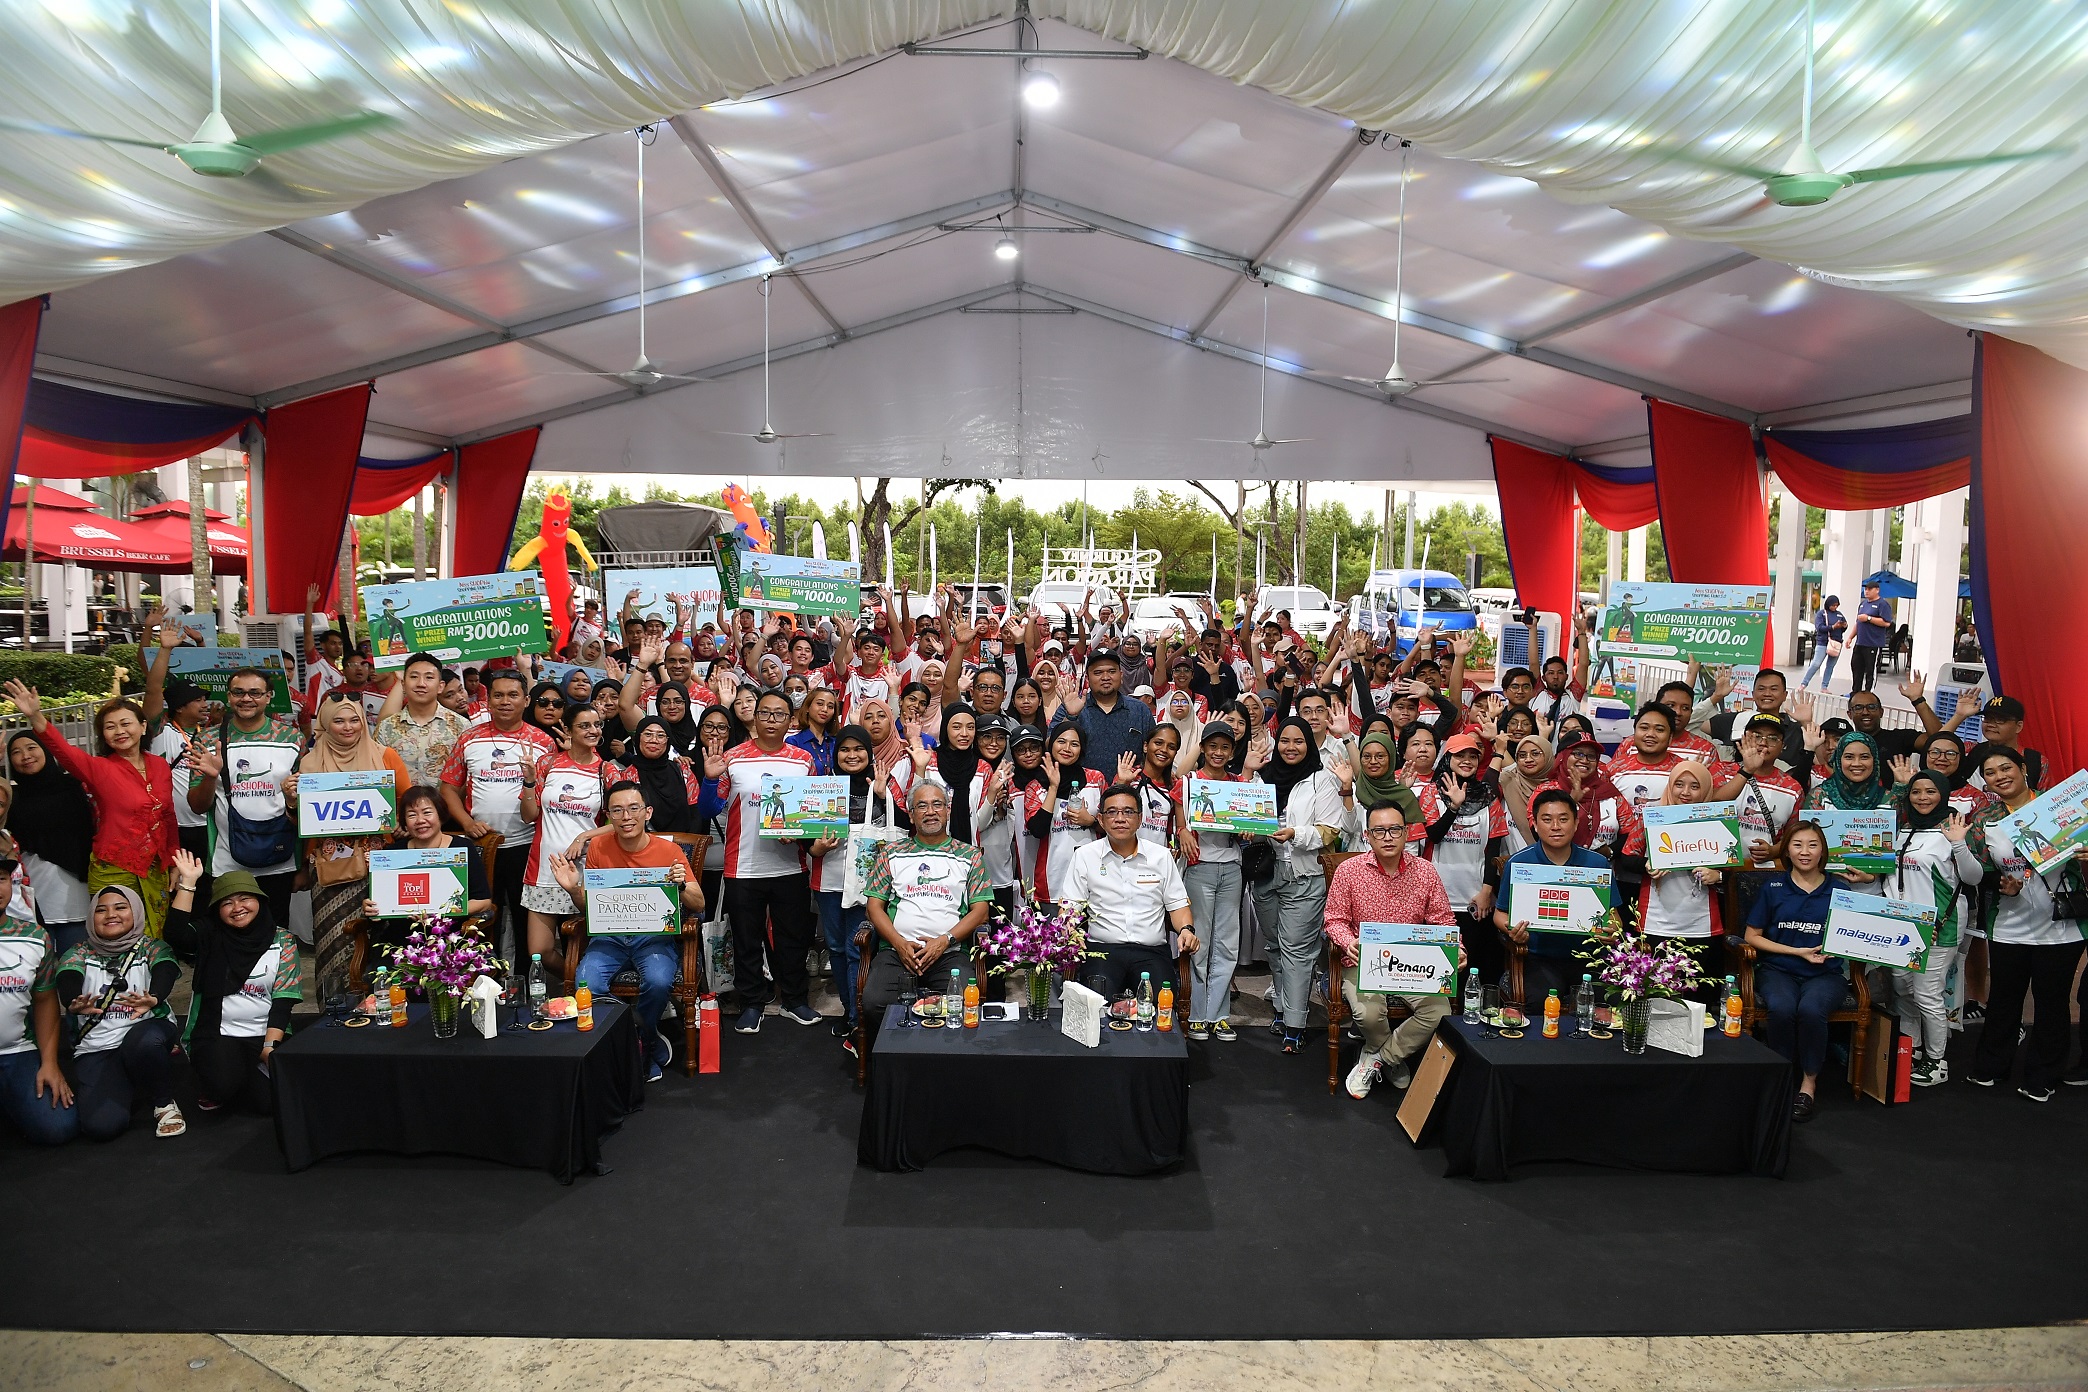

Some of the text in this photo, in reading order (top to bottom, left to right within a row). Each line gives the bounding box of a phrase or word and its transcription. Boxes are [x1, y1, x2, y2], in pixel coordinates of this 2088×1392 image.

[60, 545, 171, 561] BRUSSELS BEER CAFE
[208, 545, 248, 556] USSELS
[769, 577, 839, 591] CONGRATULATIONS
[791, 588, 848, 604] RM1000.00
[413, 606, 512, 628] CONGRATULATIONS
[1643, 613, 1737, 627] CONGRATULATIONS
[423, 627, 445, 636] PRIZE
[447, 620, 529, 642] RM3000.00
[1649, 625, 1670, 633] PRIZE
[415, 635, 446, 644] WINNER
[1641, 631, 1669, 639] WINNER
[1670, 626, 1749, 646] RM3000.00
[480, 769, 495, 778] Miss
[241, 780, 274, 790] SHOPhia
[822, 782, 844, 790] SHOPhia
[308, 799, 373, 822] VISA
[549, 800, 591, 812] Miss SHOPhia
[1674, 838, 1719, 855] firefly
[2002, 857, 2021, 866] Miss
[404, 885, 421, 893] TOP
[907, 884, 950, 894] Miss SHOPhia
[612, 893, 648, 902] GURNEY
[902, 891, 930, 899] SHOPPING
[1540, 890, 1569, 900] PDC
[598, 902, 656, 914] PARAGON
[1778, 920, 1822, 932] malaysia
[1836, 927, 1893, 945] malaysia
[1388, 954, 1436, 979] Penang
